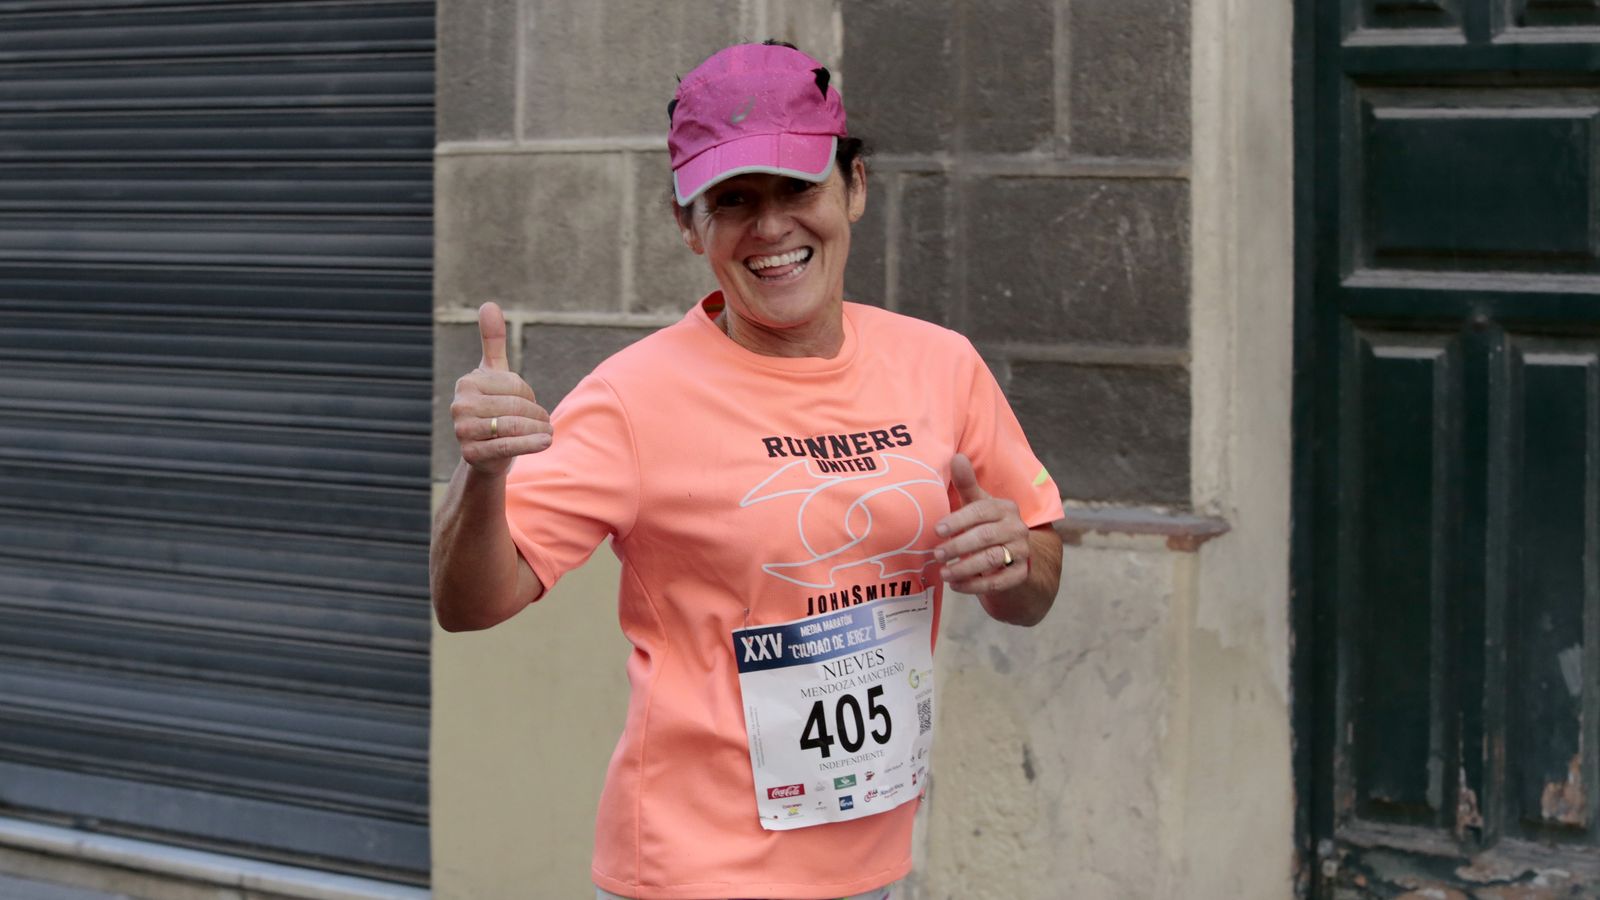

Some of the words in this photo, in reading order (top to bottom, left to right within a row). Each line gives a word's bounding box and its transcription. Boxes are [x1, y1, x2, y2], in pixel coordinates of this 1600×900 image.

[762, 424, 913, 459] RUNNERS
[816, 456, 877, 473] UNITED
[806, 580, 912, 616] JOHNSMITH
[800, 622, 822, 637] MEDIA
[832, 634, 845, 650] DE
[740, 632, 782, 663] XXV
[822, 648, 885, 680] NIEVES
[800, 679, 856, 699] MENDOZA
[857, 662, 905, 684] MANCHEÑO
[800, 684, 892, 758] 405
[819, 750, 886, 772] INDEPENDIENTE
